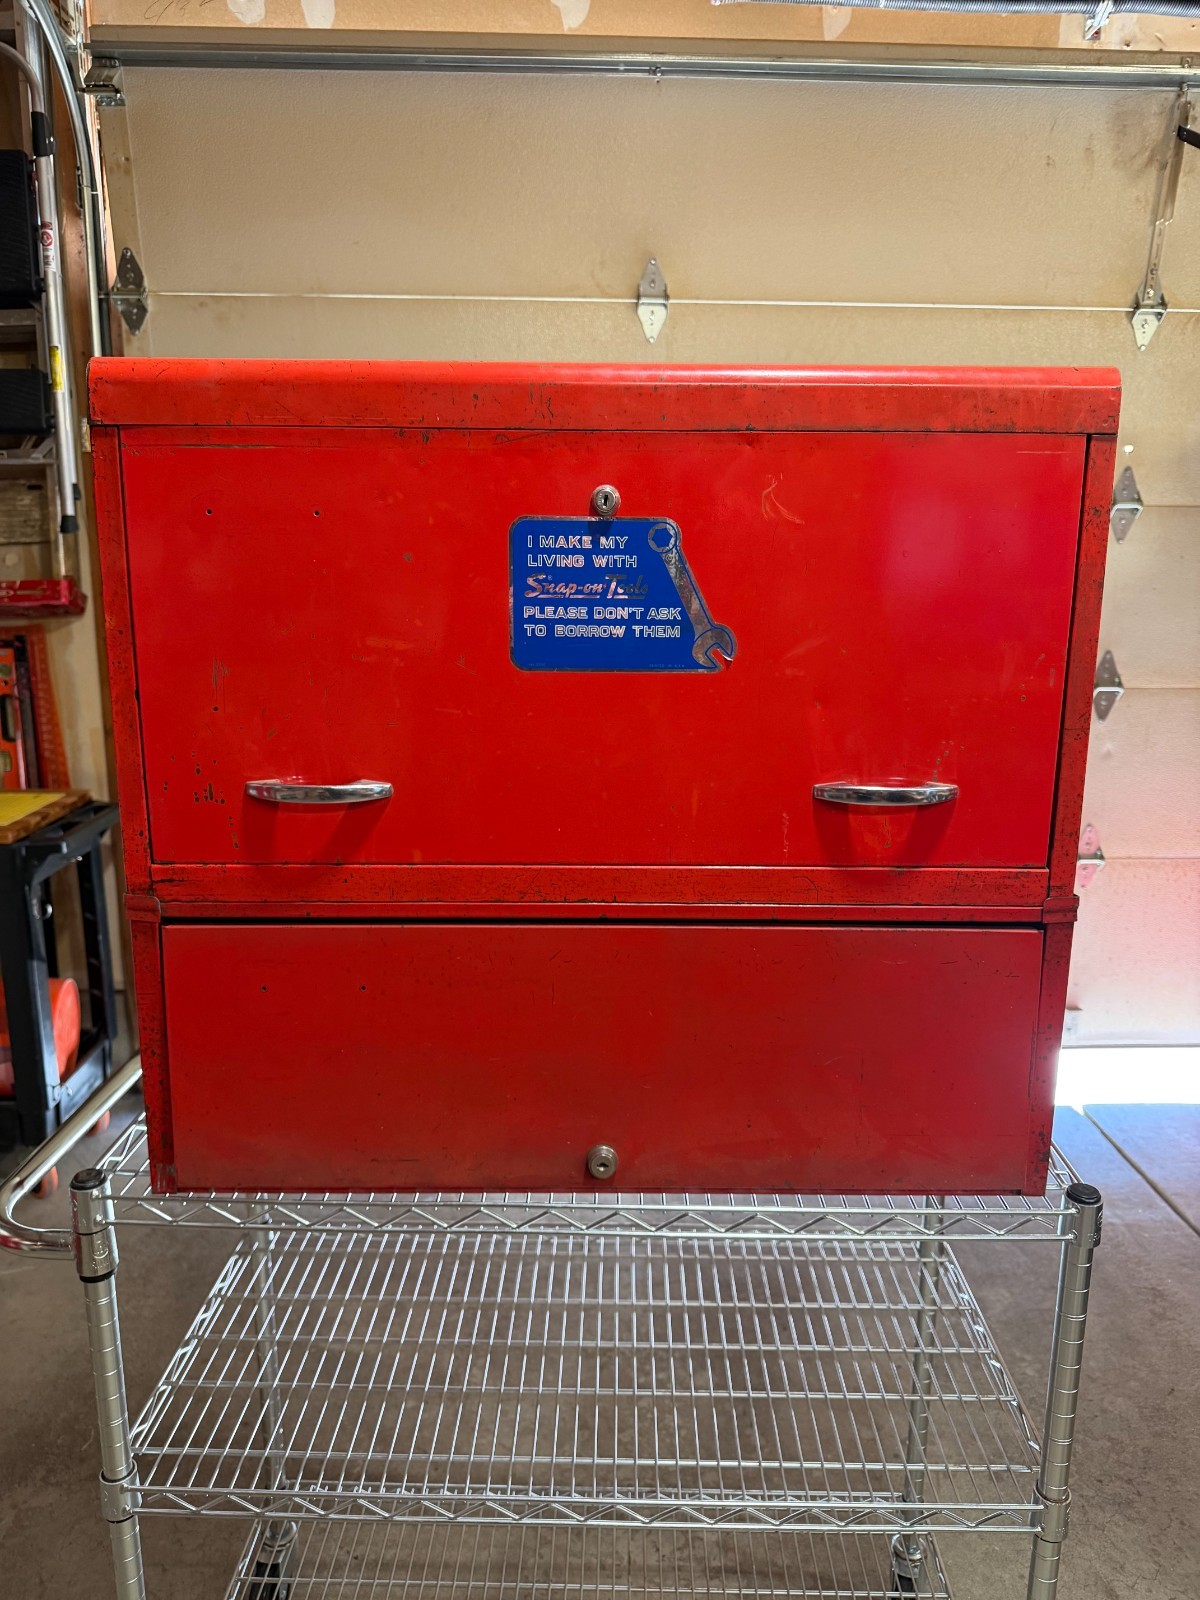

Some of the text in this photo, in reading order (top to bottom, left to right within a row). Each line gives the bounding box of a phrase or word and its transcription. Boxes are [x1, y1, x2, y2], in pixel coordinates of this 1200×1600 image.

[527, 535, 629, 549] I MAKE MY
[527, 554, 638, 568] LIVING WITH
[524, 573, 649, 599] Snap-on Tools
[523, 606, 682, 620] PLEASE DON'T ASK
[523, 624, 681, 638] TO BORROW THEM
